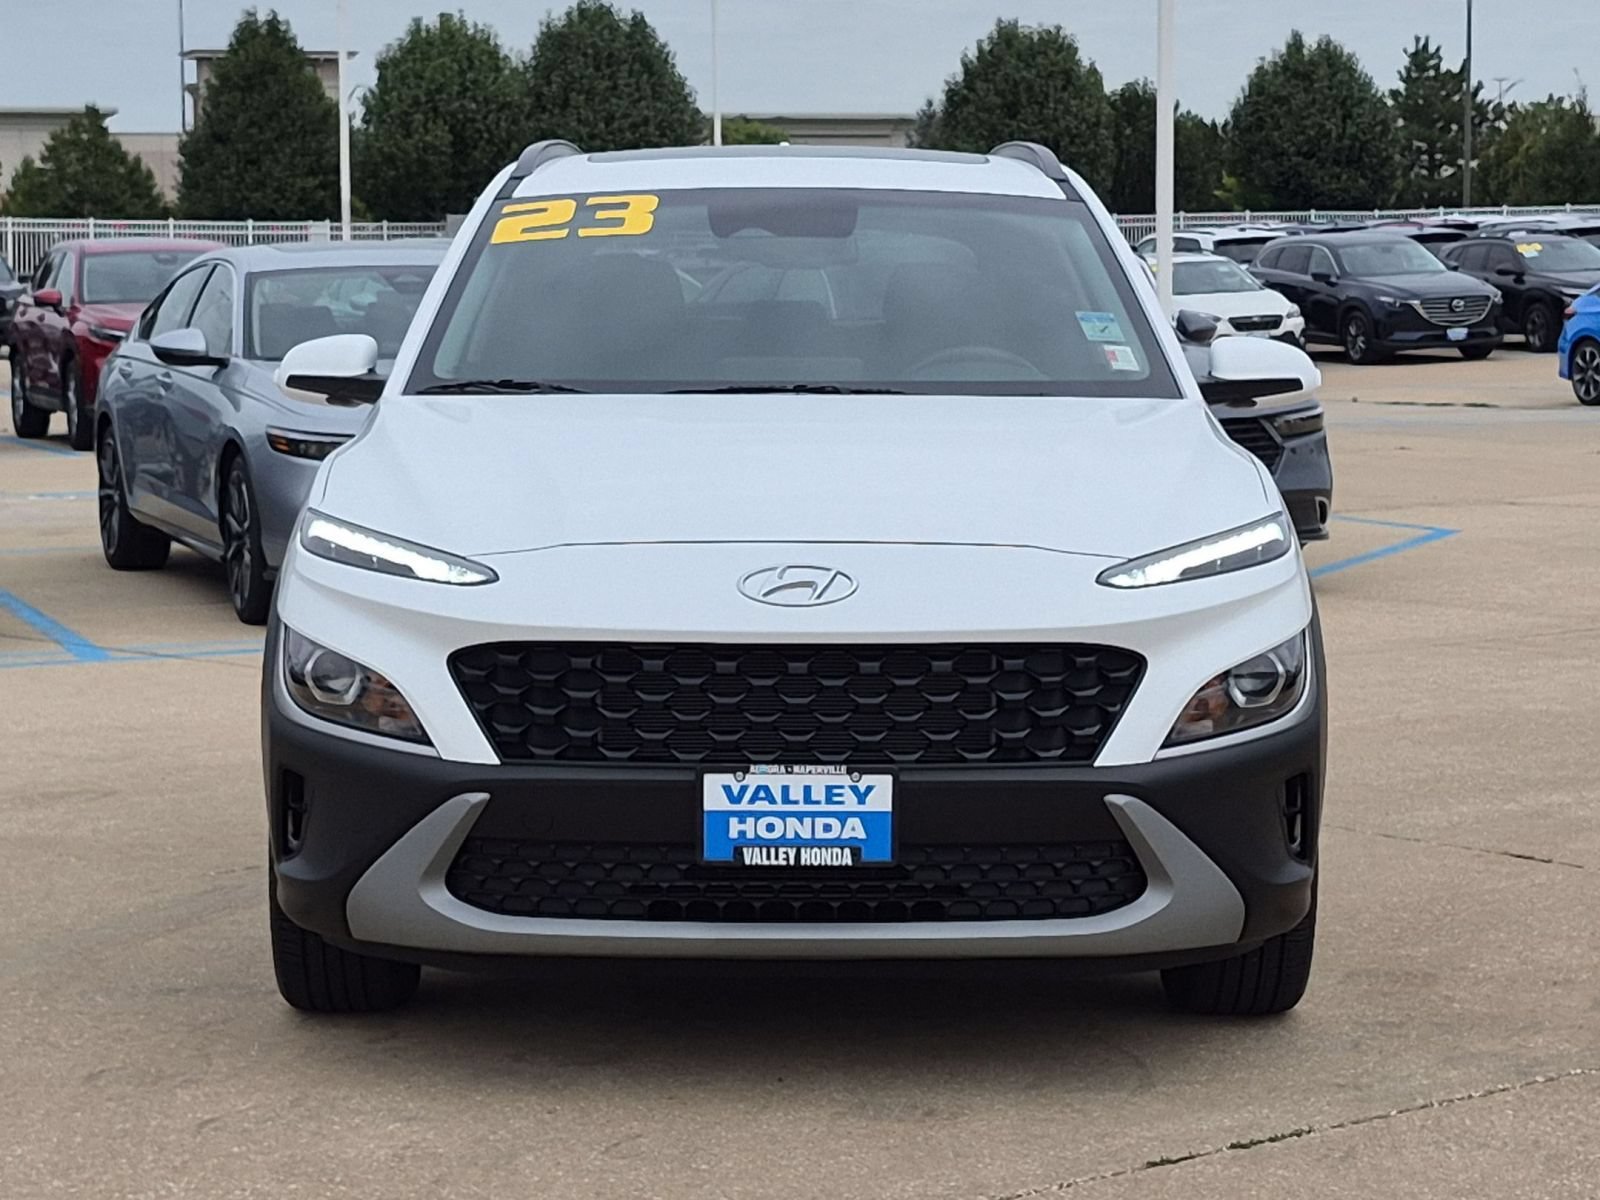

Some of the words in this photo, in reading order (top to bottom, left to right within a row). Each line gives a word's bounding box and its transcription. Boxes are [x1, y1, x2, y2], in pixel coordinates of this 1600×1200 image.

[490, 194, 660, 244] 23
[721, 784, 876, 805] VALLEY
[728, 816, 867, 839] HONDA
[742, 847, 797, 866] VALLEY
[800, 847, 853, 866] HONDA
